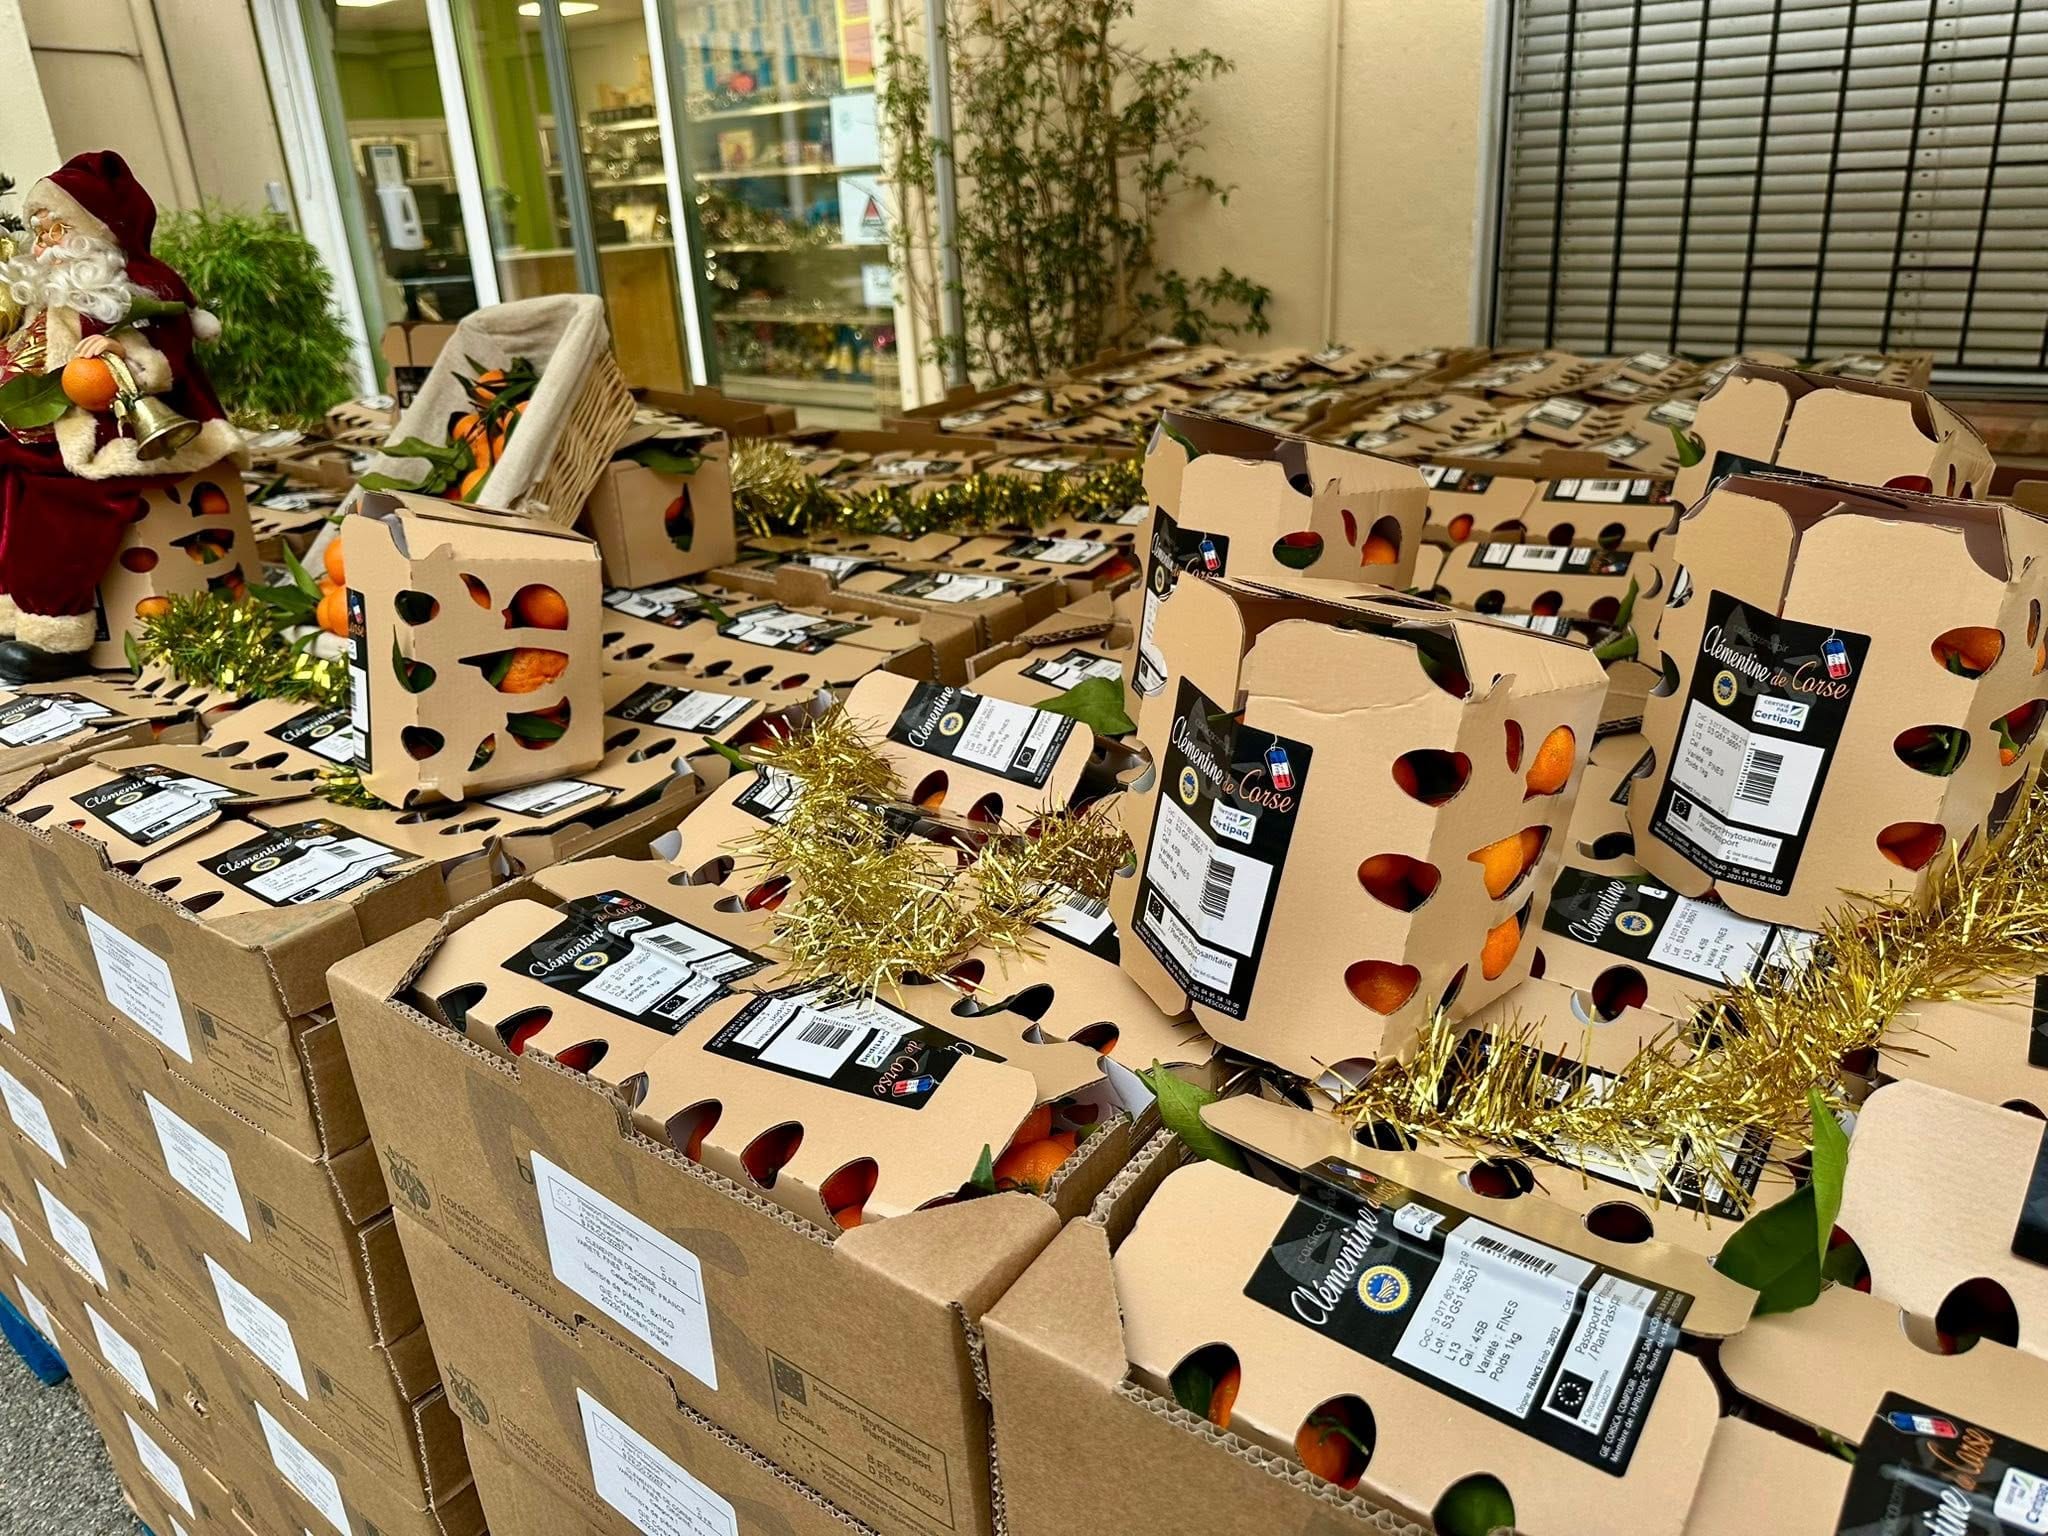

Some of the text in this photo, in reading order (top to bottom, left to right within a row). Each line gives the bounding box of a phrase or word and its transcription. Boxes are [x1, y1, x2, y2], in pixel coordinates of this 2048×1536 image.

[1702, 625, 1849, 700] Clémentine de Corse
[908, 685, 954, 747] Clémentine
[1754, 709, 1801, 728] Certipaq
[1172, 715, 1223, 787] Clémentine
[1238, 769, 1295, 813] Corse
[217, 836, 293, 876] Clémentine
[1721, 826, 1777, 850] Phytosanitaire
[1744, 877, 1781, 891] VESCOVATO
[1568, 880, 1627, 944] Clémentine
[1712, 927, 1730, 944] FINES
[859, 1030, 890, 1063] Certipaq
[873, 1041, 923, 1096] de Corse
[1291, 1208, 1380, 1326] Clémentine
[1449, 1266, 1466, 1284] 392
[1454, 1249, 1473, 1268] 219
[1428, 1263, 1481, 1354] Lot S3 G51 36501
[1432, 1297, 1450, 1318] 017
[1442, 1282, 1458, 1300] 601
[613, 1293, 640, 1318] Corsica
[641, 1312, 673, 1343] Comptoir
[1416, 1326, 1436, 1348] CoC
[1472, 1298, 1520, 1376] Variété FINES
[1571, 1304, 1606, 1356] Passeport
[1588, 1326, 1610, 1354] Plant
[1443, 1340, 1463, 1362] L13
[1456, 1319, 1490, 1368] Cal 4/5B
[1487, 1330, 1523, 1382] Poids 1kg
[1525, 1364, 1544, 1390] FRANCE
[1545, 1325, 1561, 1346] 28032
[1598, 1336, 1653, 1458] GIE CORSICA COMPTOIR 20230 SAN
[1608, 1427, 1631, 1463] Membre
[1622, 1415, 1635, 1429] de
[1645, 1347, 1663, 1372] Route
[1654, 1335, 1667, 1349] du
[877, 1469, 893, 1486] FR
[911, 1481, 945, 1508] 00257
